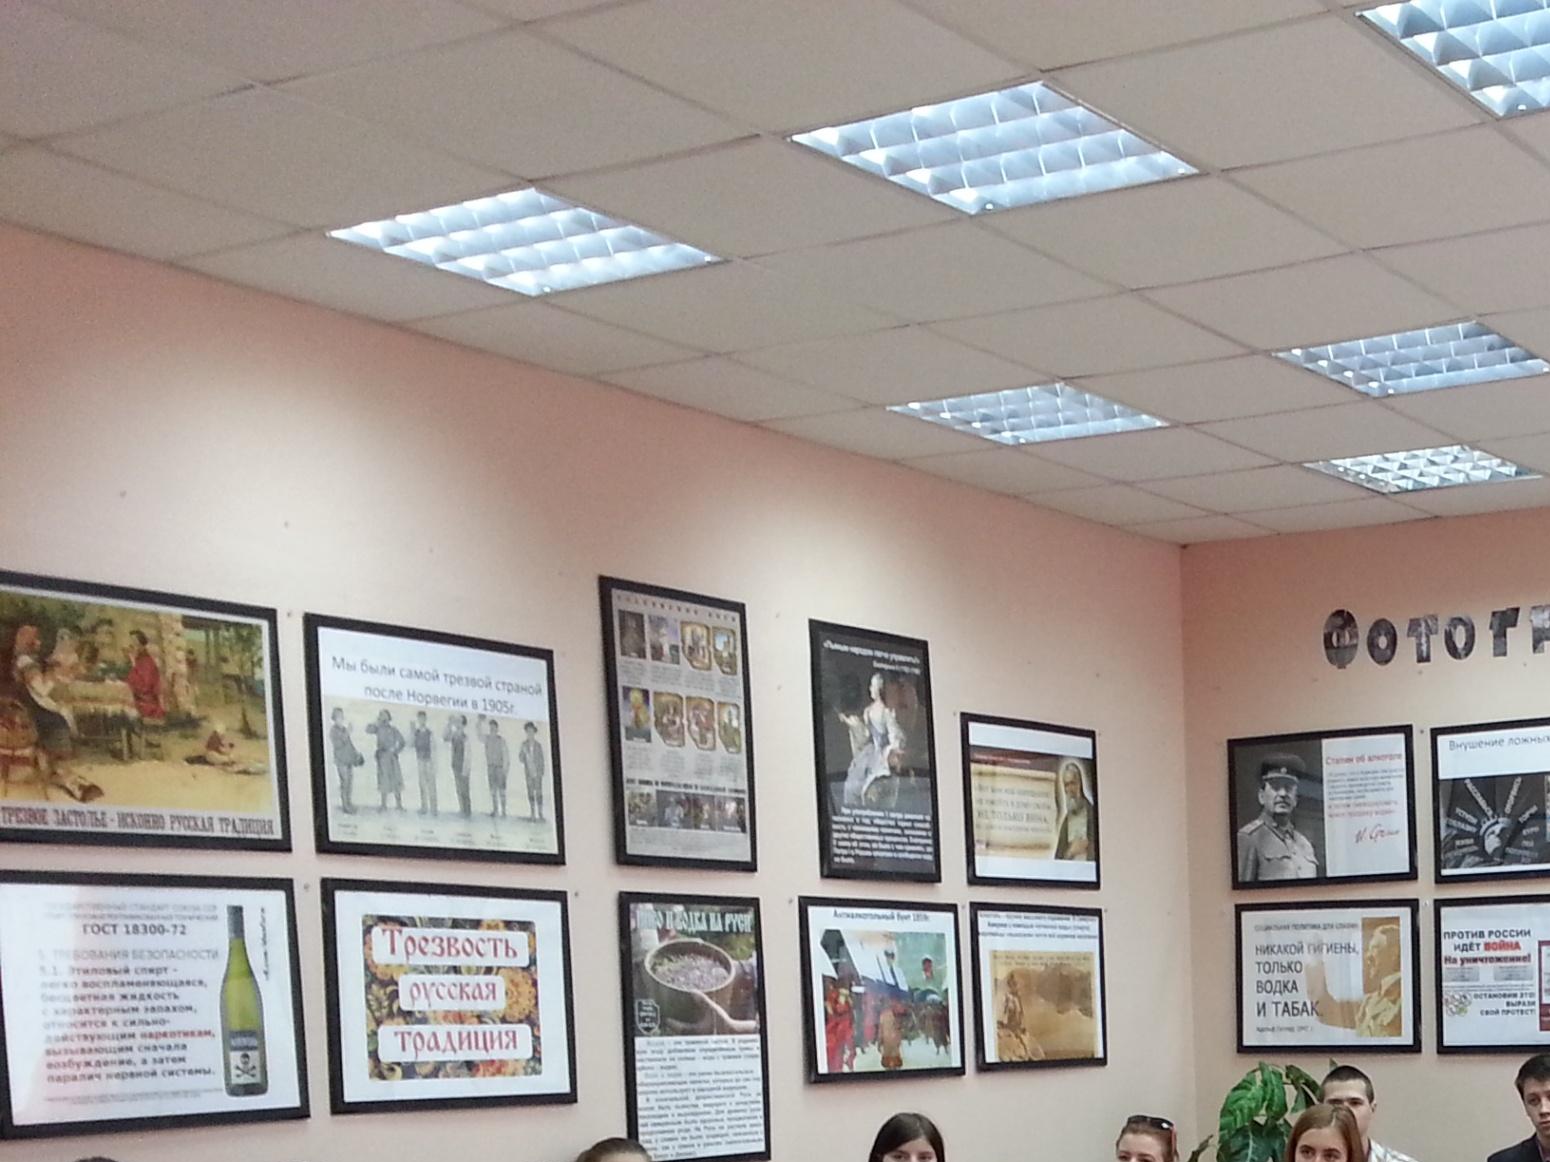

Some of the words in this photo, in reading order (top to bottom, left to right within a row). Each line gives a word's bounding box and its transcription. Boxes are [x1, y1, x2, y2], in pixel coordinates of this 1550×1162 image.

[332, 656, 356, 671] Мы
[360, 659, 396, 676] были
[400, 668, 440, 683] самой
[443, 672, 493, 690] трезвой
[495, 680, 543, 697] страной
[364, 686, 403, 700] после
[407, 689, 469, 709] Норвегии
[472, 701, 479, 710] в
[1449, 737, 1505, 752] Внушение
[1508, 734, 1550, 747] ложных
[169, 814, 215, 834] РУССКАЯ
[218, 816, 275, 837] ТРАДИЦИЯ
[82, 923, 119, 936] ГОСТ
[124, 923, 187, 936] 18300-72
[1443, 930, 1486, 940] ПРОТИВ
[1488, 928, 1532, 939] РОССИИ
[382, 928, 518, 961] Трезвость
[1255, 941, 1304, 956] НИКАКОЙ
[1453, 940, 1481, 953] ИДЁТ
[1483, 940, 1522, 952] ВОЙНА
[1256, 961, 1303, 974] ТОЛЬКО
[1444, 956, 1458, 965] На
[1459, 953, 1532, 967] уничтожение!
[409, 981, 497, 1007] русская
[1256, 980, 1299, 996] ВОДКА
[1256, 1001, 1267, 1017] И
[1480, 1007, 1500, 1017] СВОЙ
[394, 1029, 518, 1058] традиция
